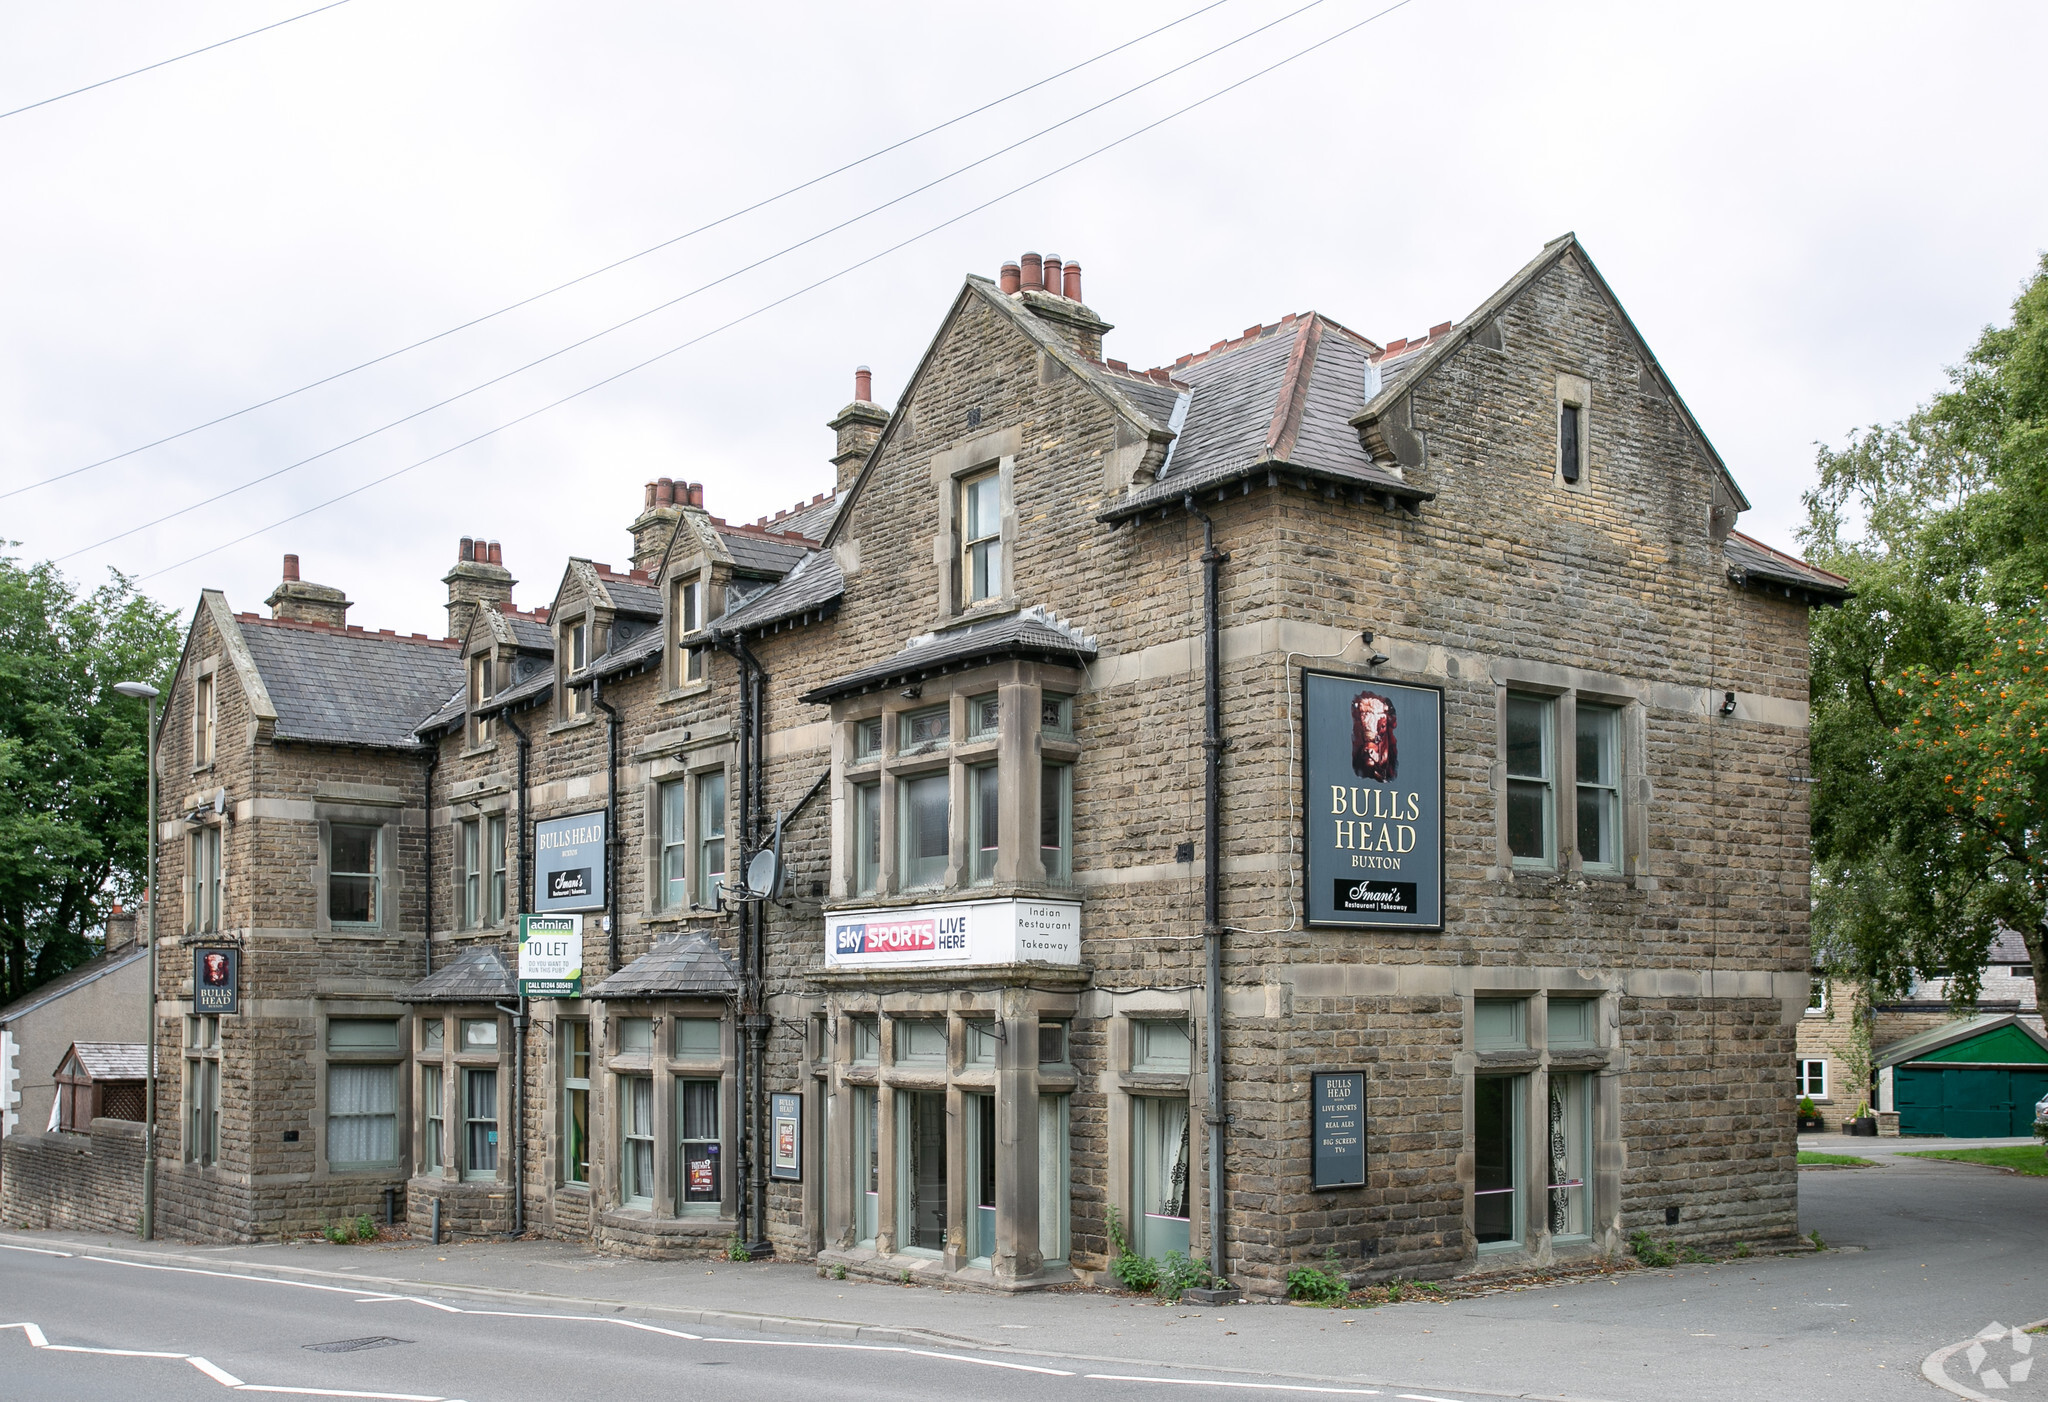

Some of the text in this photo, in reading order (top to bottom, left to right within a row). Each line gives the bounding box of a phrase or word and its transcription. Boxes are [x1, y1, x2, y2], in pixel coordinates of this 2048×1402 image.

[1330, 784, 1420, 821] BULLS
[540, 825, 601, 850] BULLS HEAD
[1334, 819, 1416, 853] HEAD
[1351, 855, 1401, 870] BUXTON
[1348, 880, 1401, 903] Imani's
[1029, 907, 1061, 917] Indian
[1344, 900, 1408, 912] Restaurant Takeaway
[530, 919, 572, 930] admiral
[939, 917, 966, 934] LIVE
[1018, 918, 1071, 930] Restaurant
[838, 923, 934, 953] sky SPORTS
[938, 934, 966, 950] HERE
[527, 941, 568, 956] TO LET
[1021, 939, 1068, 952] Takeaway
[528, 981, 540, 989] CALL
[541, 981, 555, 989] 01244
[1327, 1080, 1352, 1088] BULLS
[1328, 1089, 1350, 1097] HEAD
[1335, 1137, 1357, 1145] SCREEN
